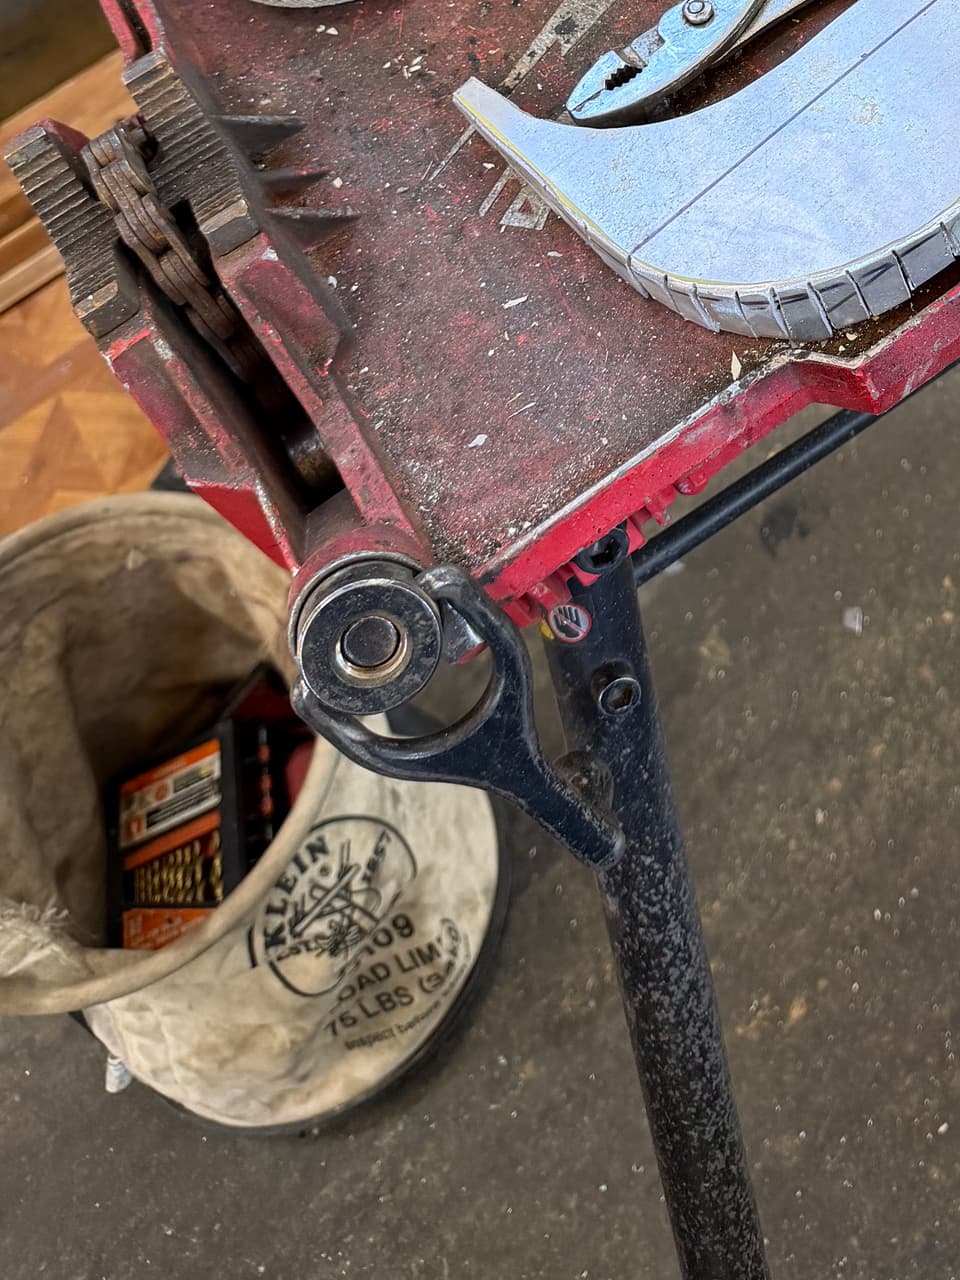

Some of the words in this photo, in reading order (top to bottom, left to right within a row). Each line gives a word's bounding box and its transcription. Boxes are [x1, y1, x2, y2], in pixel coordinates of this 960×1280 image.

[264, 834, 331, 952] KLEIN
[334, 962, 391, 1005] OAD
[358, 985, 415, 1019] LBS
